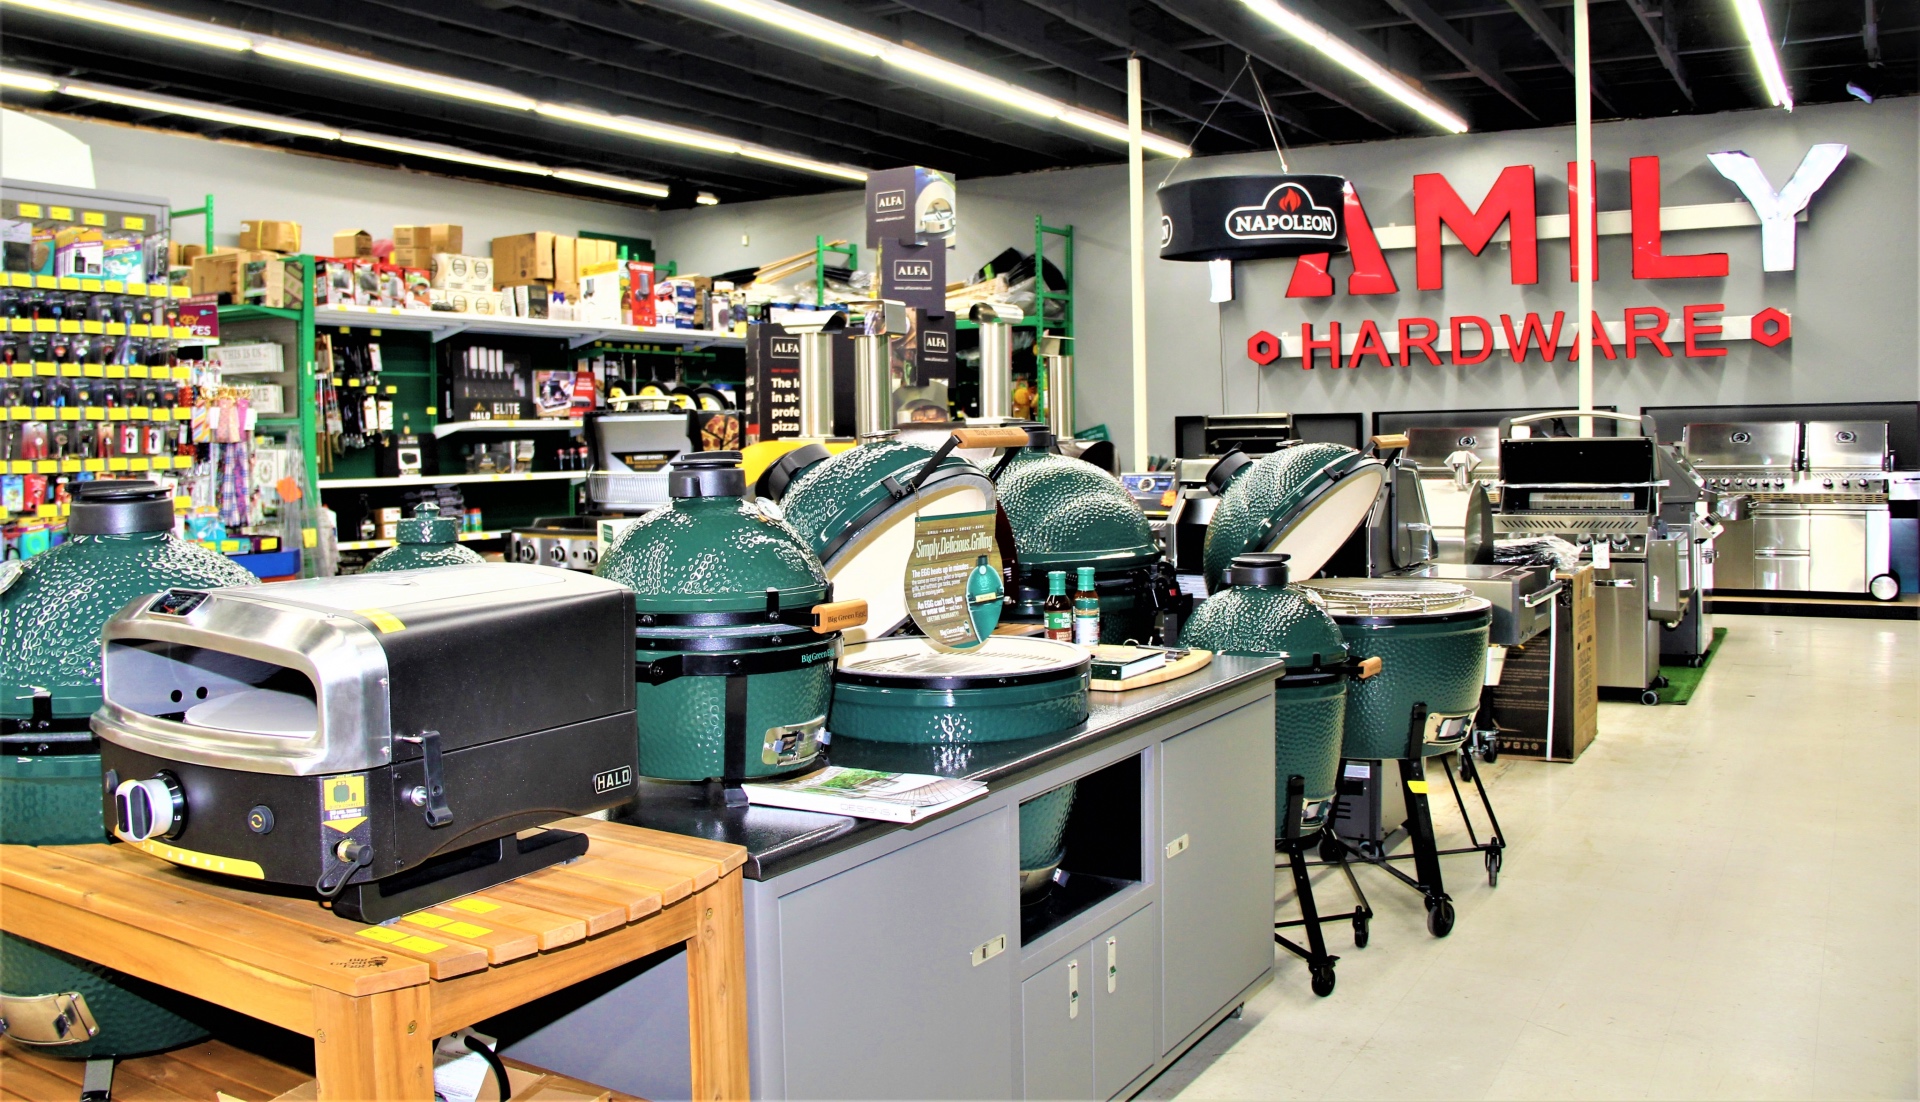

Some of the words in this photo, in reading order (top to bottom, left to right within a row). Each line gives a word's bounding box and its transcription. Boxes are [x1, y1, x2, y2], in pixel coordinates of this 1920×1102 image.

[878, 196, 902, 208] ALFA
[1208, 143, 1849, 303] AMILY
[1236, 214, 1332, 232] NAPOLEON
[898, 266, 928, 276] ALFA
[1302, 303, 1728, 370] HARDWARE
[774, 343, 800, 353] ALFA
[926, 337, 946, 348] ALFA
[771, 378, 791, 388] The
[772, 392, 782, 402] in
[470, 412, 491, 420] HALO
[772, 421, 799, 434] pizza
[912, 570, 920, 578] The
[921, 568, 930, 577] EGG
[924, 600, 933, 608] EGG
[802, 654, 812, 663] Big
[812, 650, 827, 660] Green
[827, 648, 835, 657] Egg
[597, 770, 630, 791] HALO
[840, 804, 890, 816] DESIGNS
